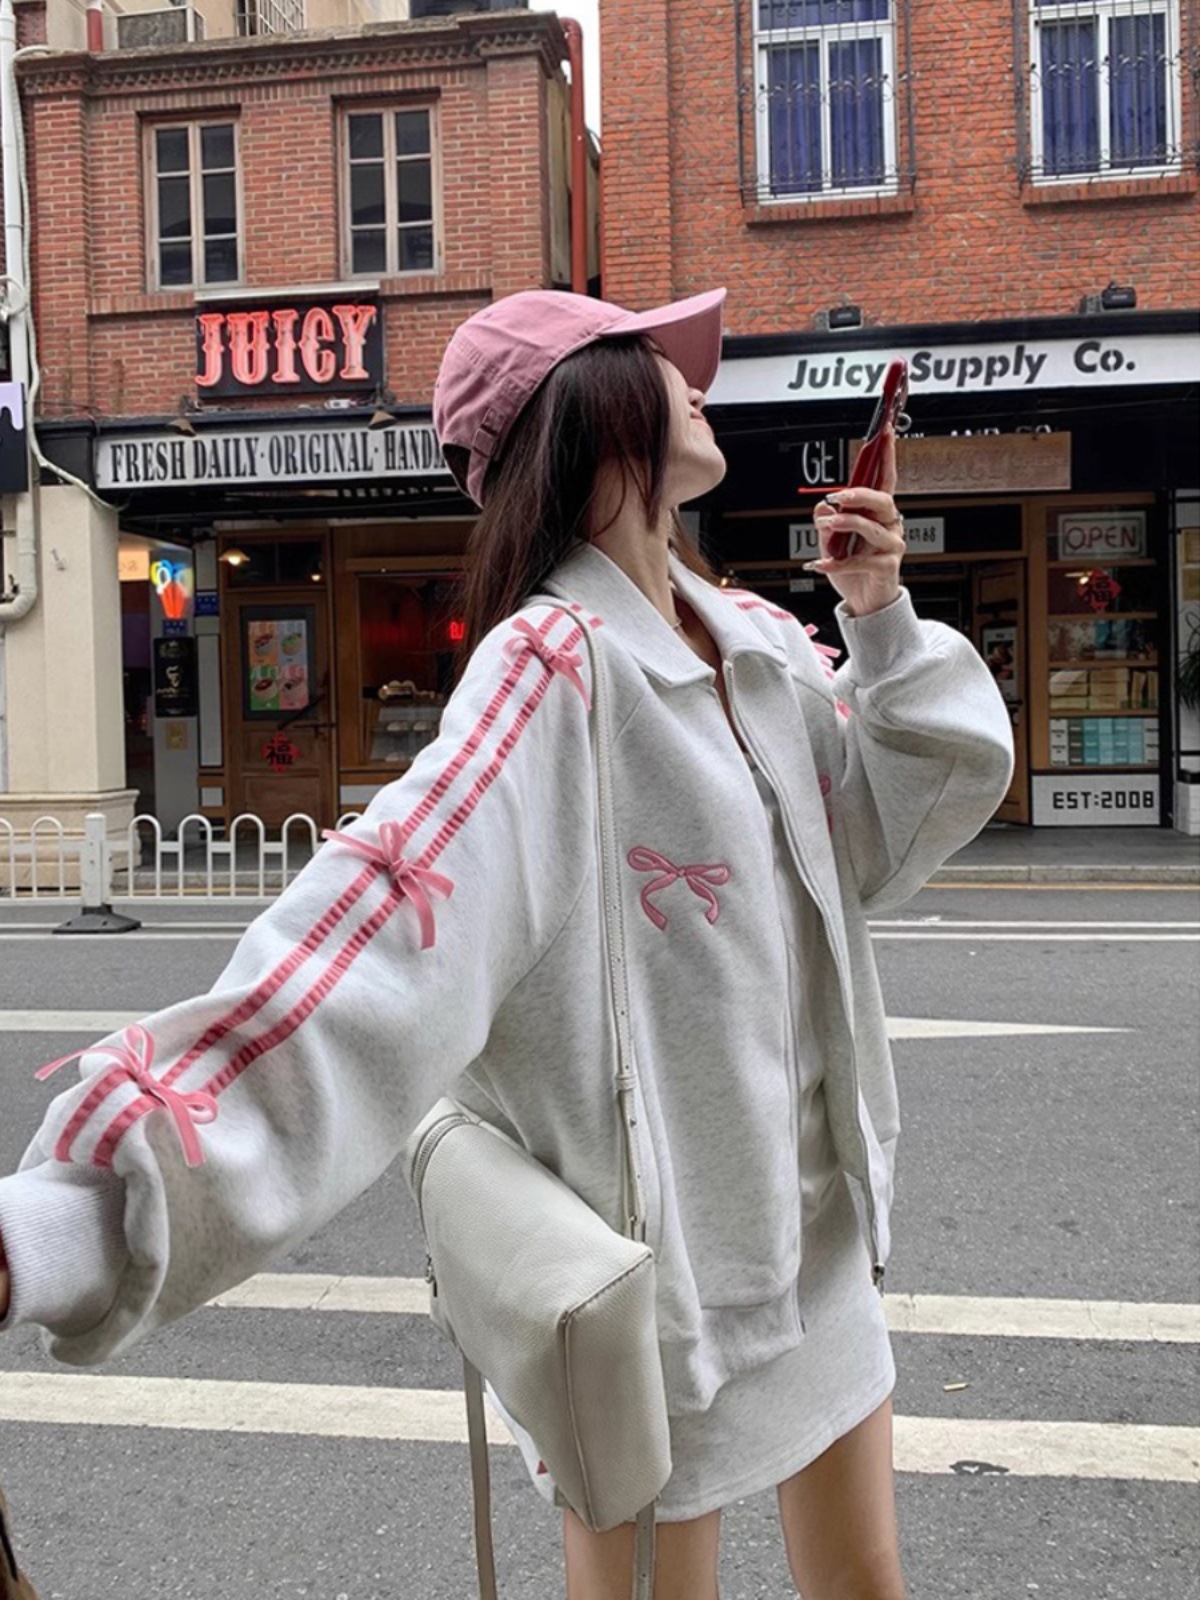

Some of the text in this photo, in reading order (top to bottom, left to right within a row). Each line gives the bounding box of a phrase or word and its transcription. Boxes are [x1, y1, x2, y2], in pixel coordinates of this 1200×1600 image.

[195, 305, 376, 387] JUICY
[787, 341, 1136, 394] Juicy Supply Co.
[110, 440, 186, 483] FRESH
[1066, 526, 1137, 551] OPEN
[1052, 791, 1154, 809] EST:2008
